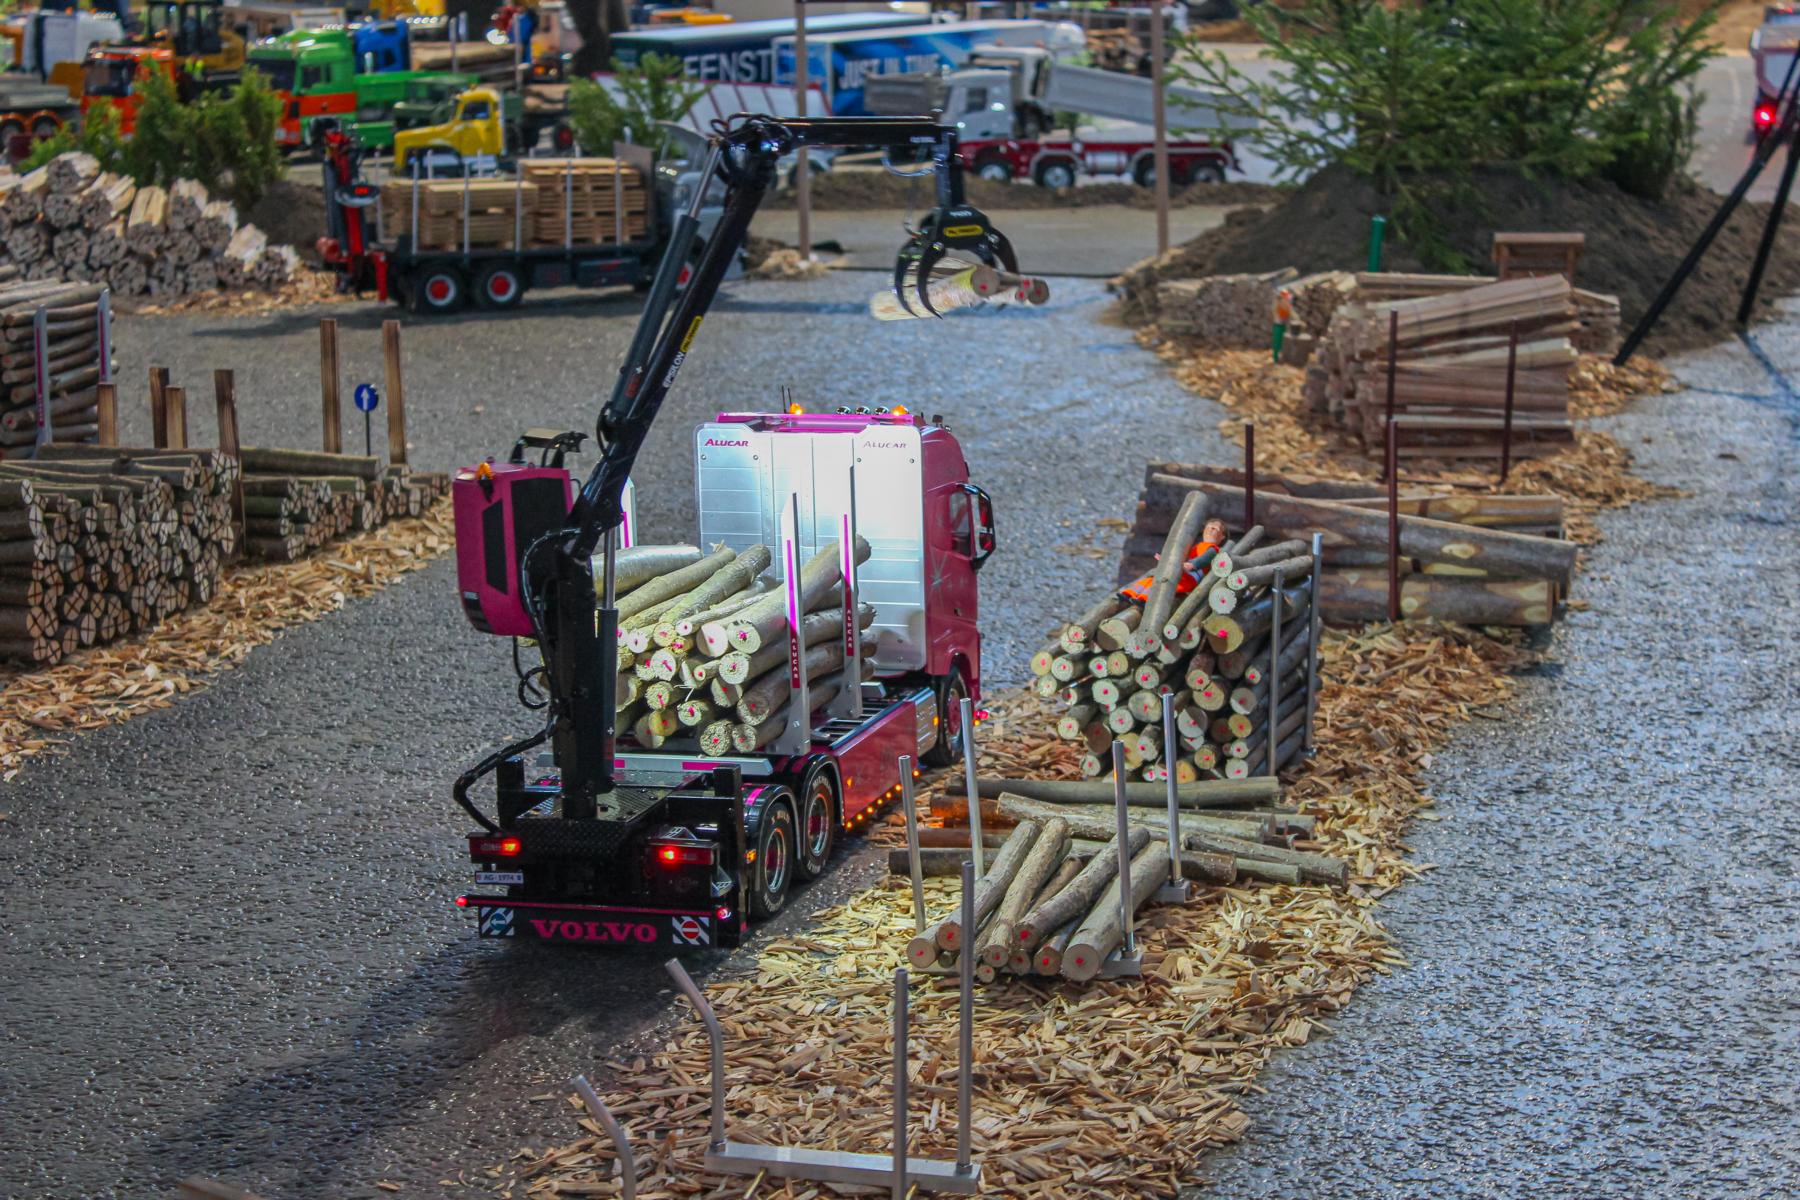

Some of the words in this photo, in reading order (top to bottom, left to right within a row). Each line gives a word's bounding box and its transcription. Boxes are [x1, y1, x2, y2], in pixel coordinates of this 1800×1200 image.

[704, 438, 749, 447] ALUCAR
[863, 440, 907, 449] ALUCAR
[791, 638, 799, 679] ALUCAR
[529, 919, 657, 943] VOLVO
